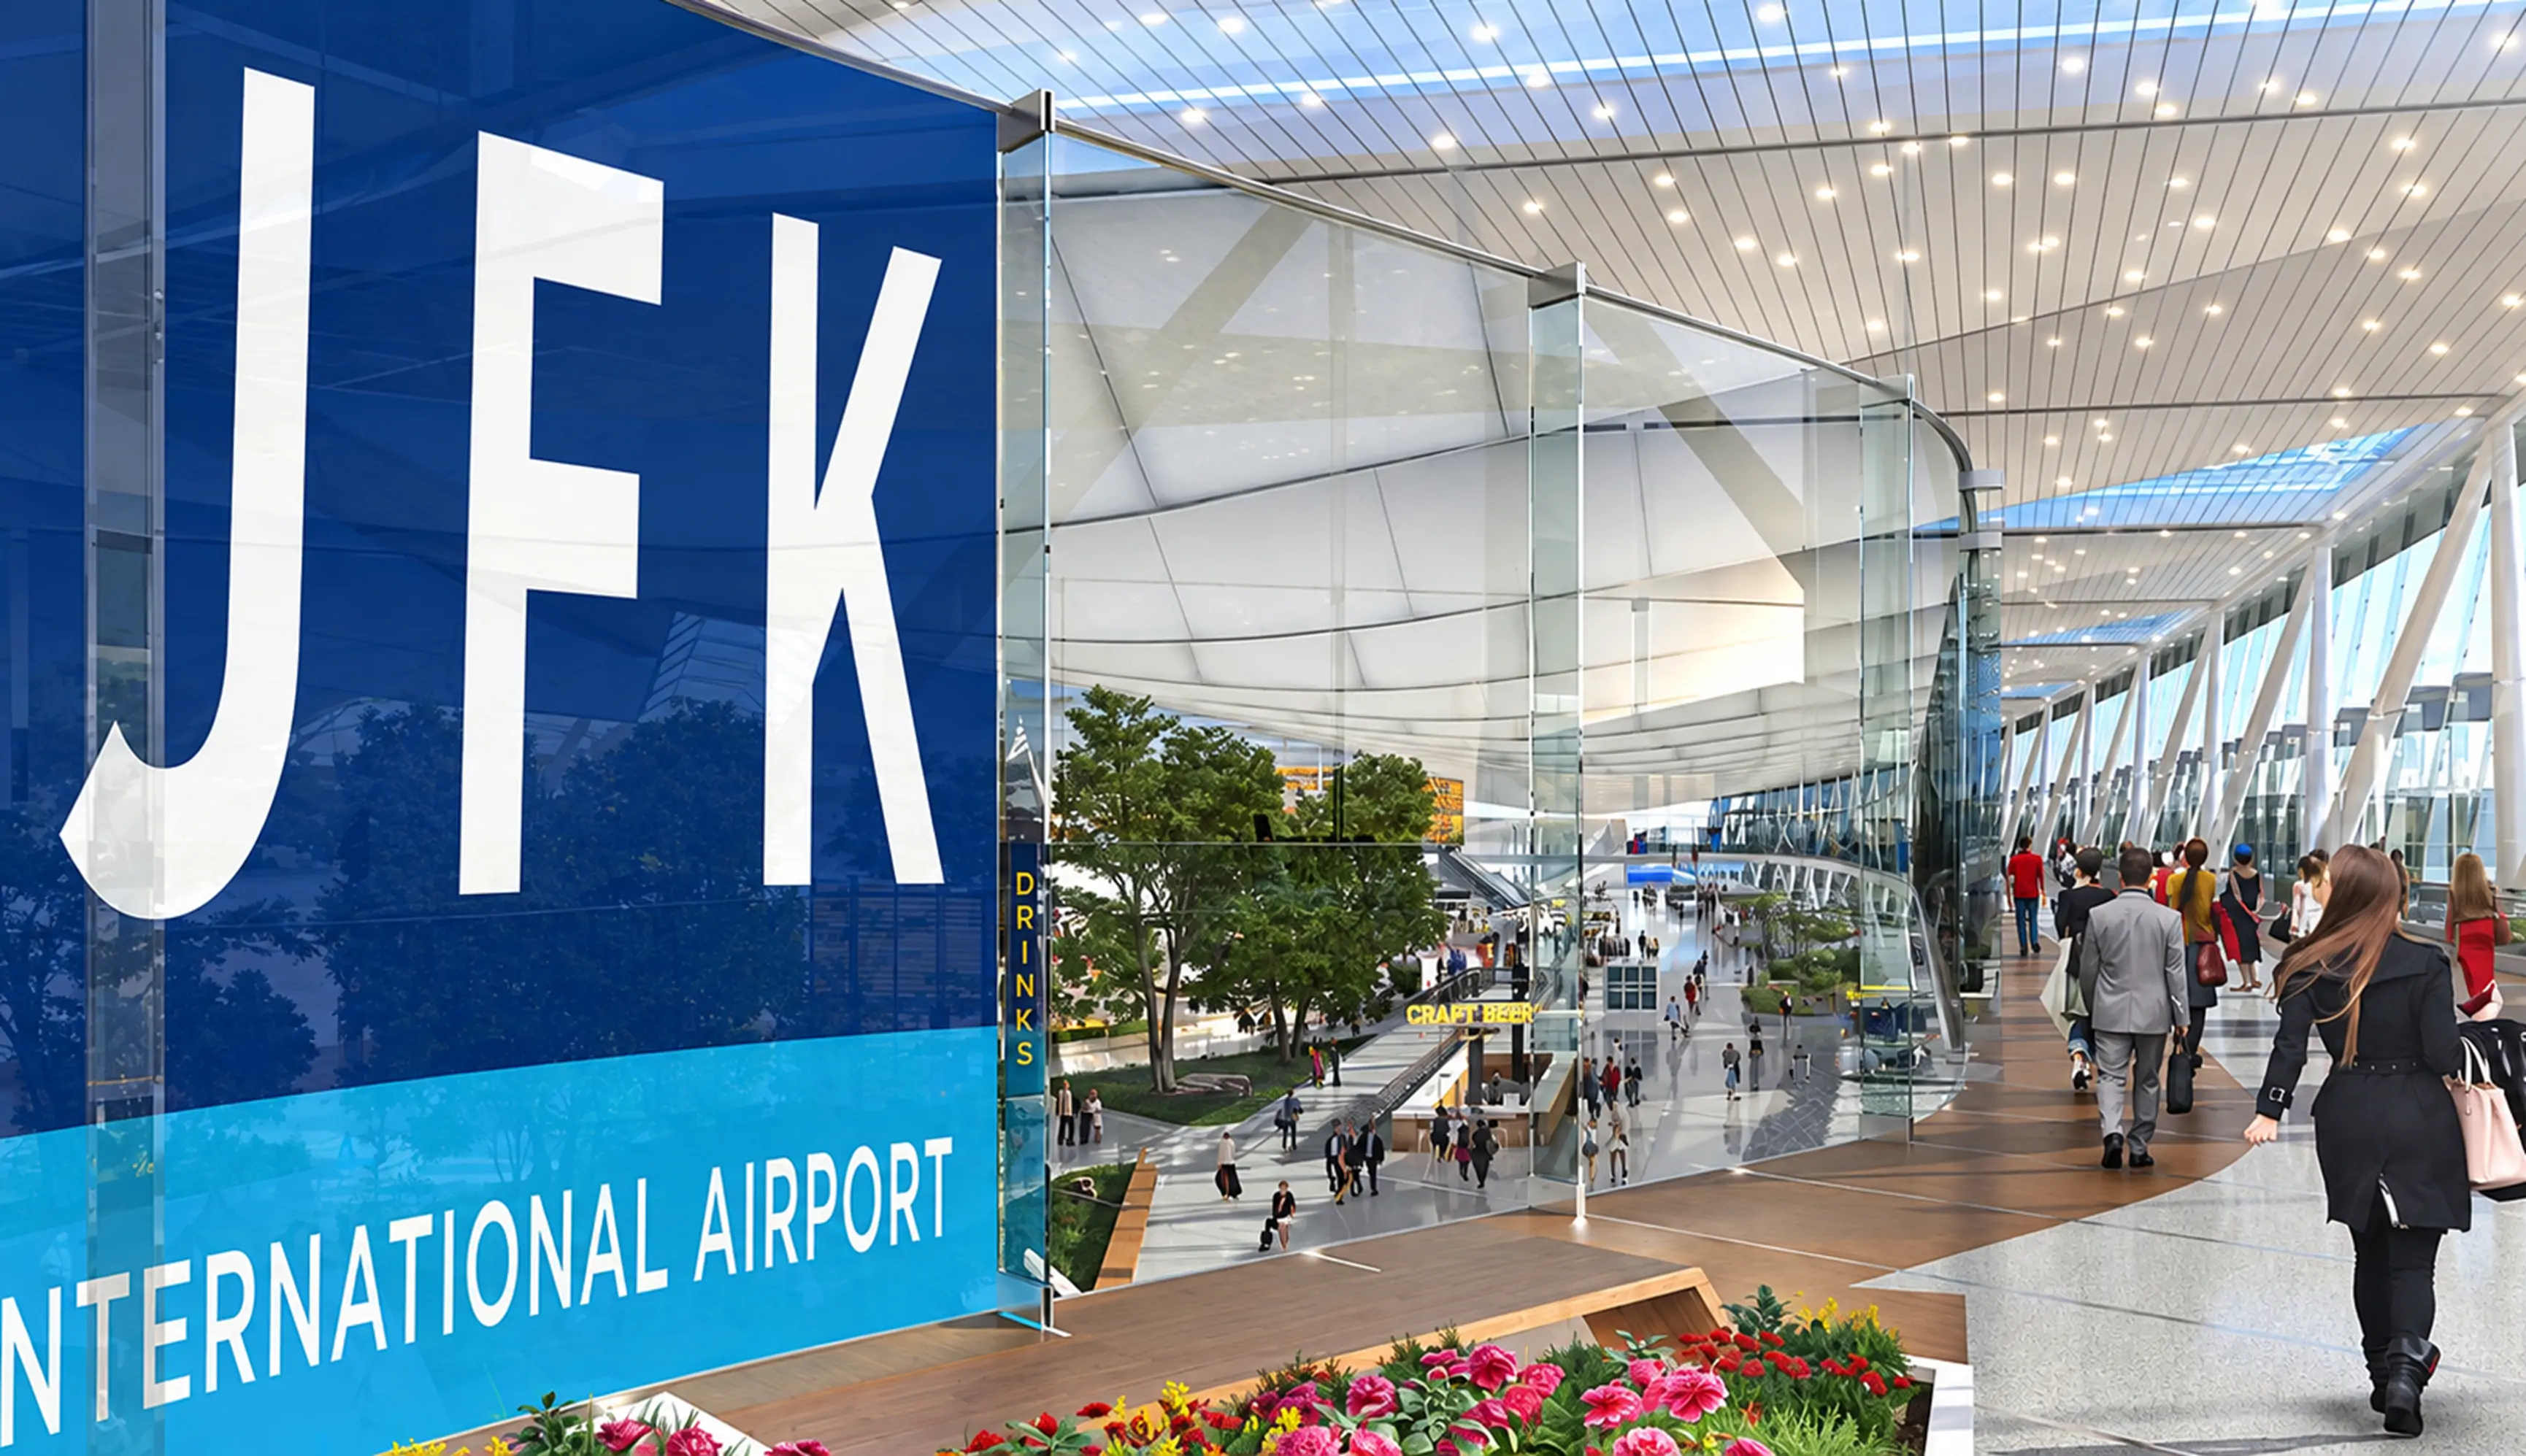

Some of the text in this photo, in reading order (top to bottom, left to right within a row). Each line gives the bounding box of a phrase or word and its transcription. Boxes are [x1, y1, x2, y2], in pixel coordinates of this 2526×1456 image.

[59, 66, 945, 920] JFK
[1016, 871, 1035, 1066] DRINKS
[1406, 1002, 1535, 1025] CRAFT BEER
[694, 1136, 953, 1282] AIRPORT
